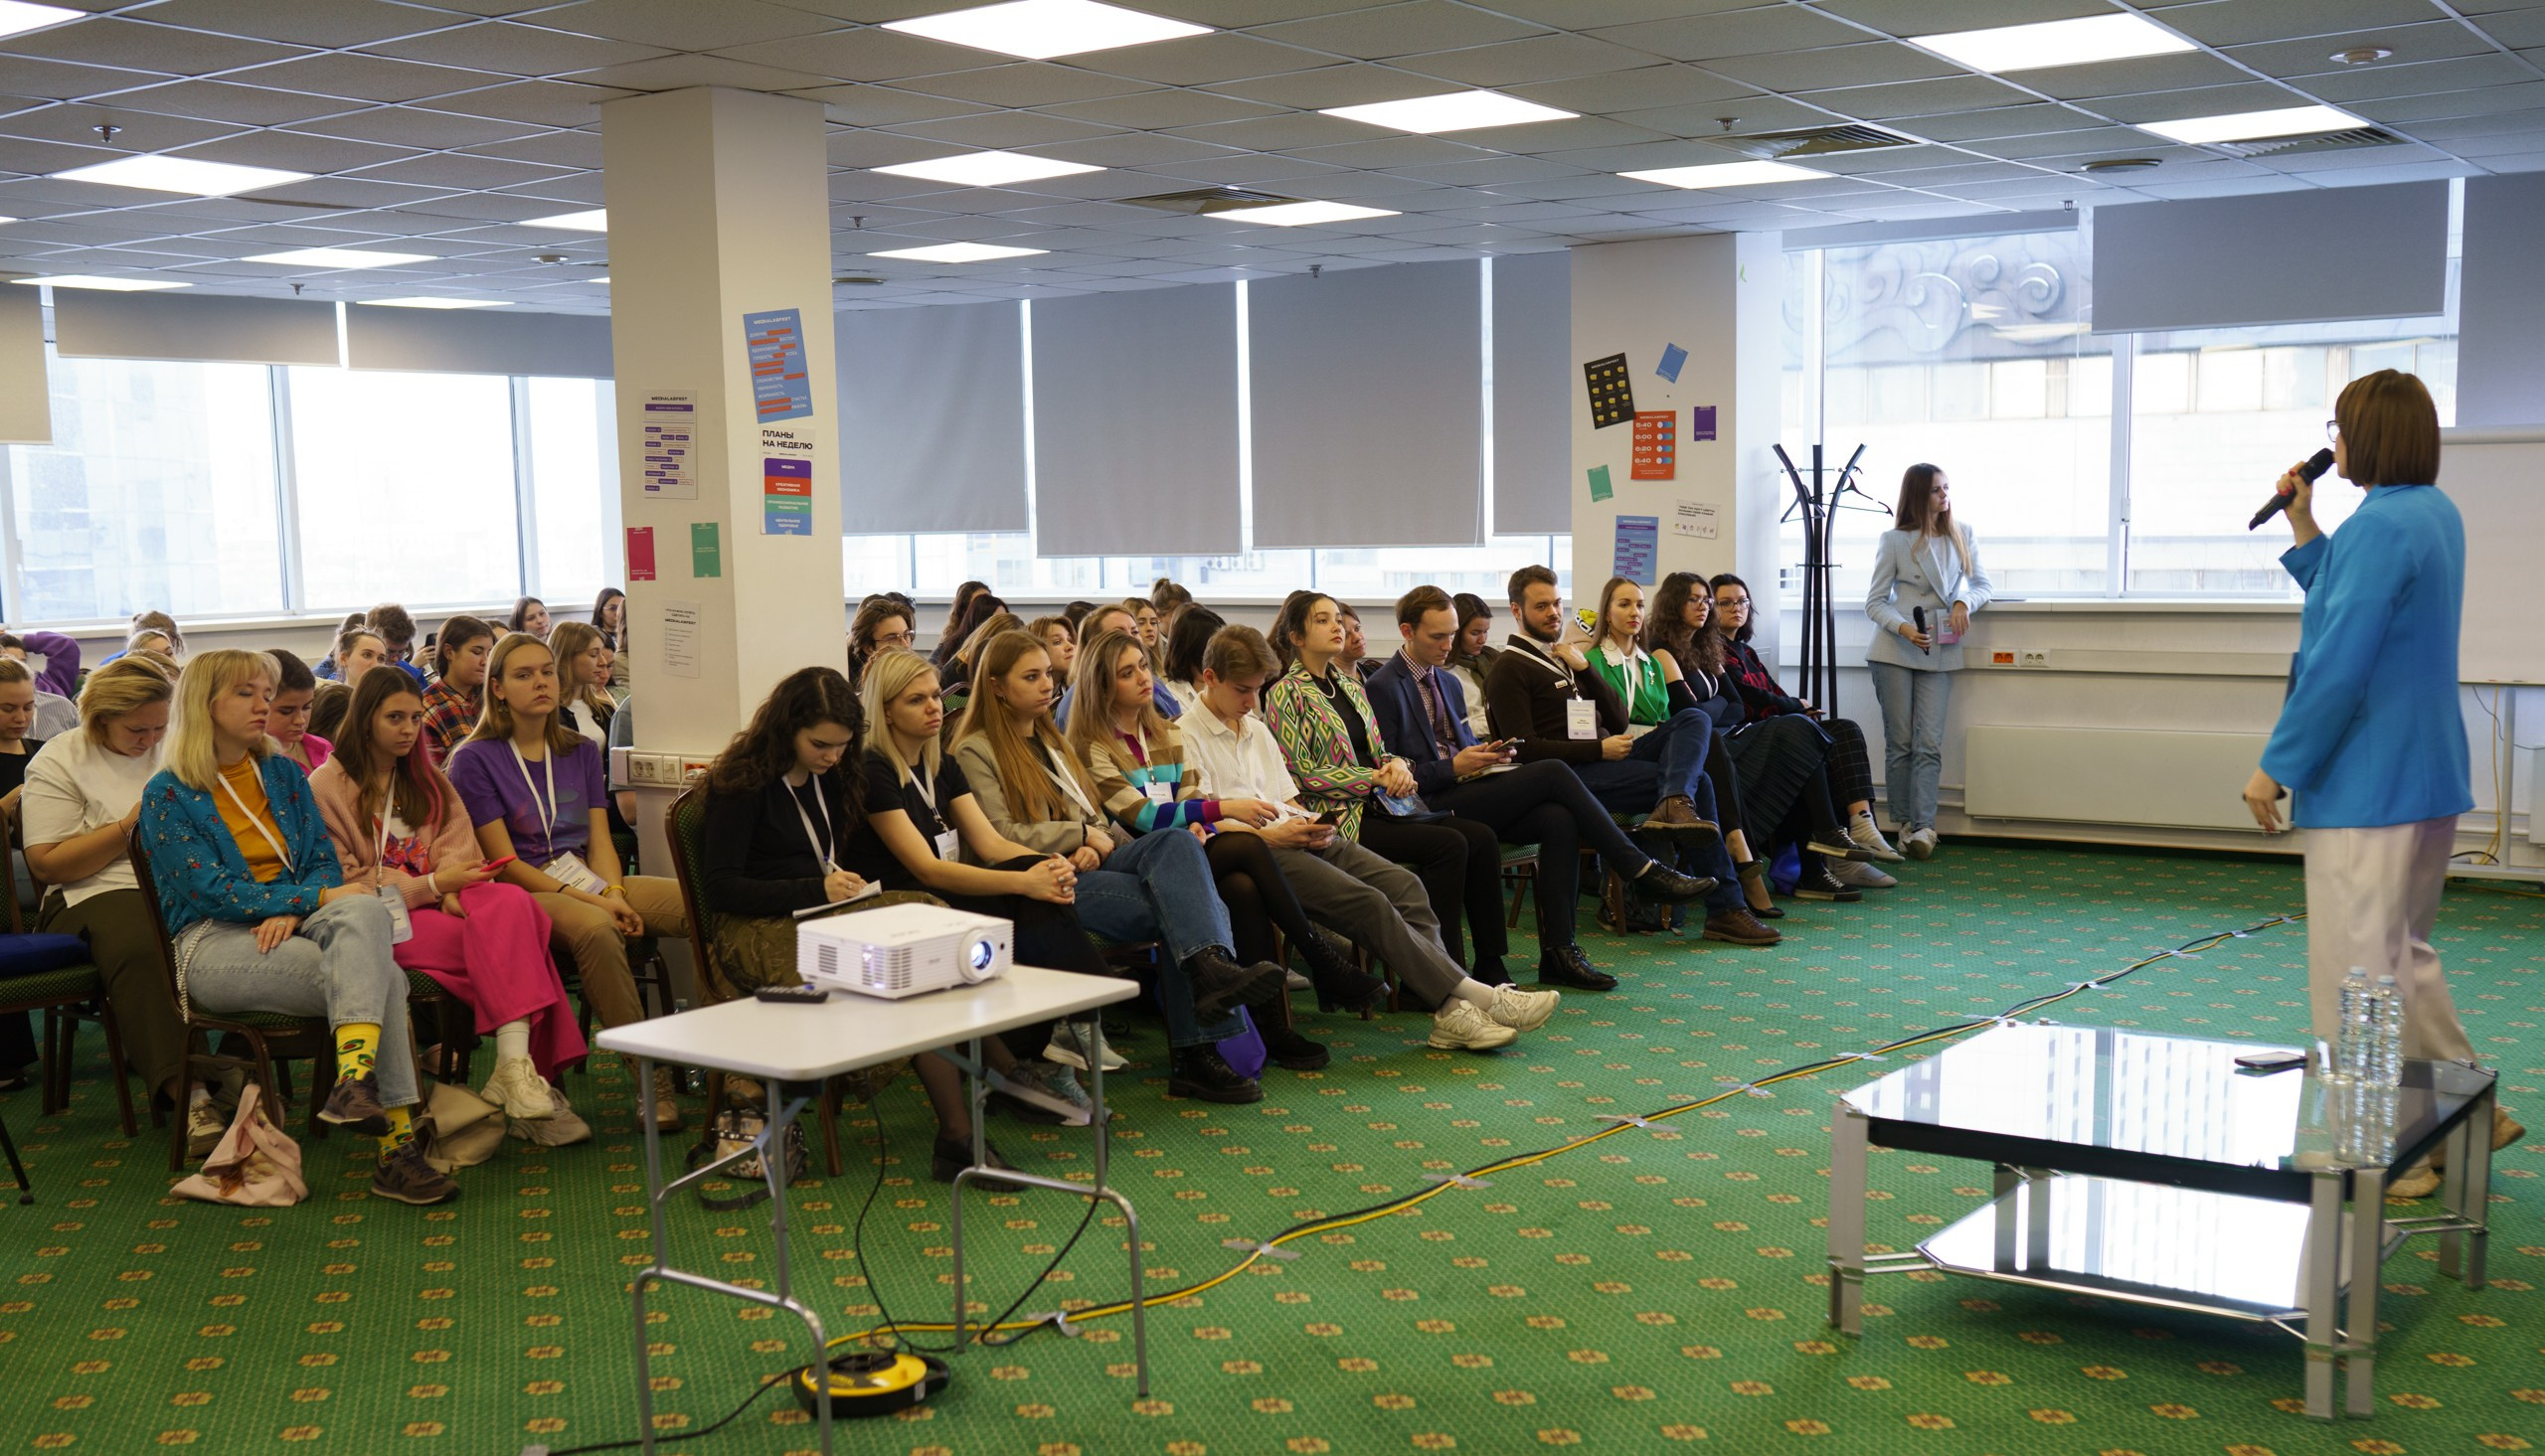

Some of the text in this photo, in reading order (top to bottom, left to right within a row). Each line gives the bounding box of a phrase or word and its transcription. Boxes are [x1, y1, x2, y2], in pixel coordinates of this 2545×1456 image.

[754, 317, 792, 325] MEDIALABFEST
[763, 429, 794, 439] ПЛАНЫ
[776, 440, 813, 450] НЕДЕЛЮ
